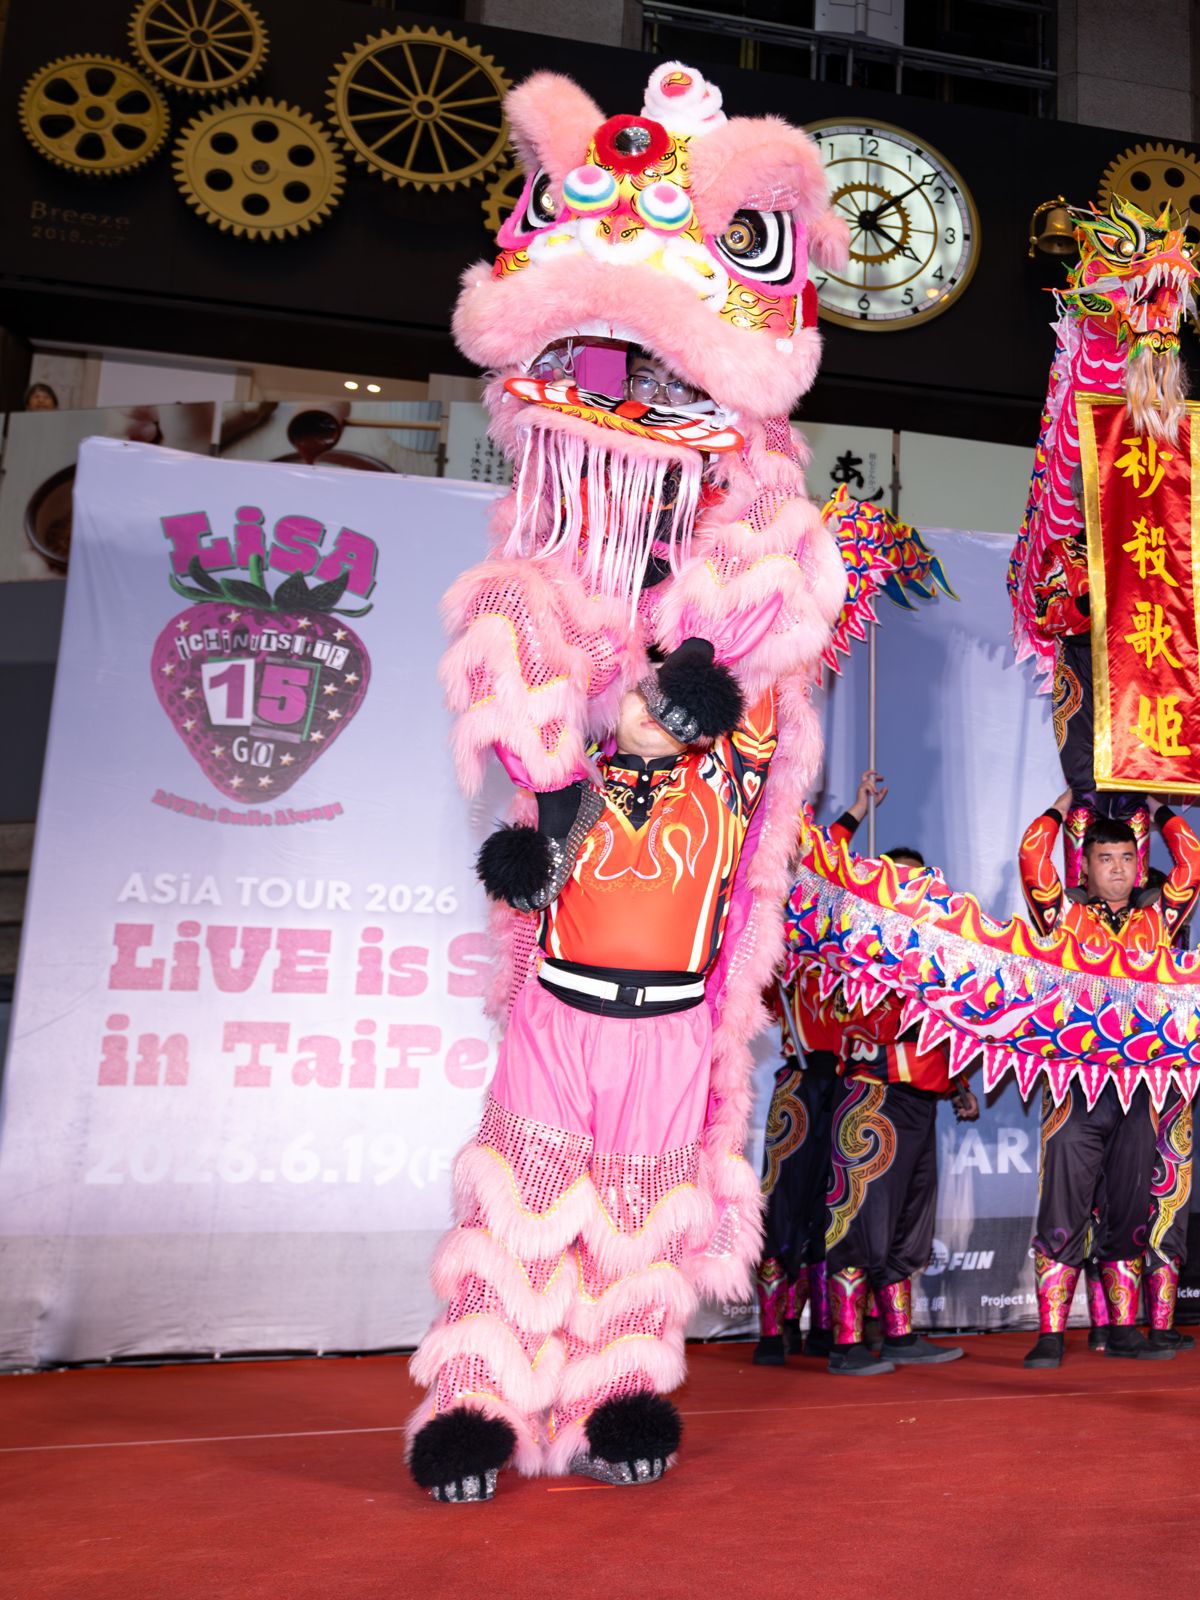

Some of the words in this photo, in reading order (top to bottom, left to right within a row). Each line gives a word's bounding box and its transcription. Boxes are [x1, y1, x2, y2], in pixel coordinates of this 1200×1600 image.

[858, 137, 879, 156] 12
[906, 155, 912, 171] 1
[934, 187, 945, 204] 2
[944, 227, 956, 244] 3
[932, 265, 944, 281] 4
[815, 276, 828, 291] 7
[857, 293, 871, 311] 6
[901, 288, 914, 305] 5
[160, 505, 377, 600] LiSA
[205, 660, 312, 727] 15
[232, 736, 275, 768] GO
[117, 872, 222, 906] ASiA
[236, 877, 352, 911] TOUR
[364, 883, 459, 915] 2026
[108, 920, 333, 995] LiVE
[354, 926, 430, 998] is
[97, 1013, 189, 1087] in
[221, 1018, 490, 1090] TaiPe
[950, 1127, 1040, 1174] AR
[948, 1250, 995, 1271] FUN
[980, 1293, 1024, 1308] Project
